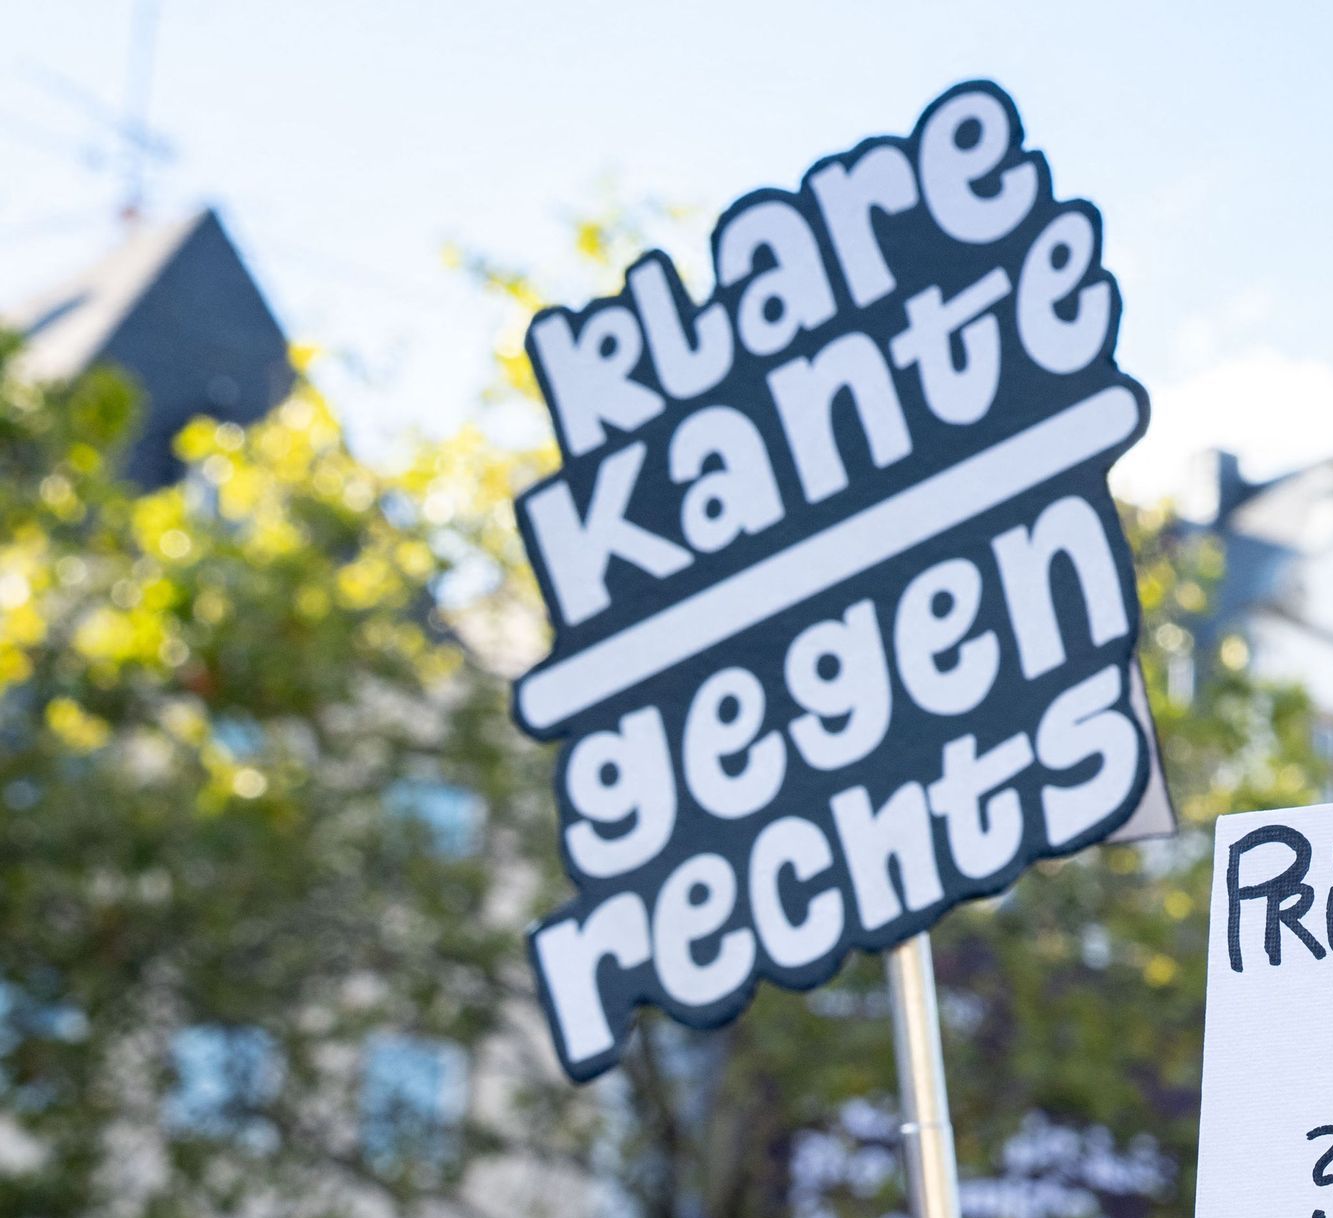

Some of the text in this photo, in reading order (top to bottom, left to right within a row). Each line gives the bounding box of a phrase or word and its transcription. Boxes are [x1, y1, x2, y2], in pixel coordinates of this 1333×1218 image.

[526, 212, 1110, 625] Kante
[533, 93, 1036, 455] klare
[538, 667, 1138, 1062] rechts
[565, 498, 1128, 878] gegen
